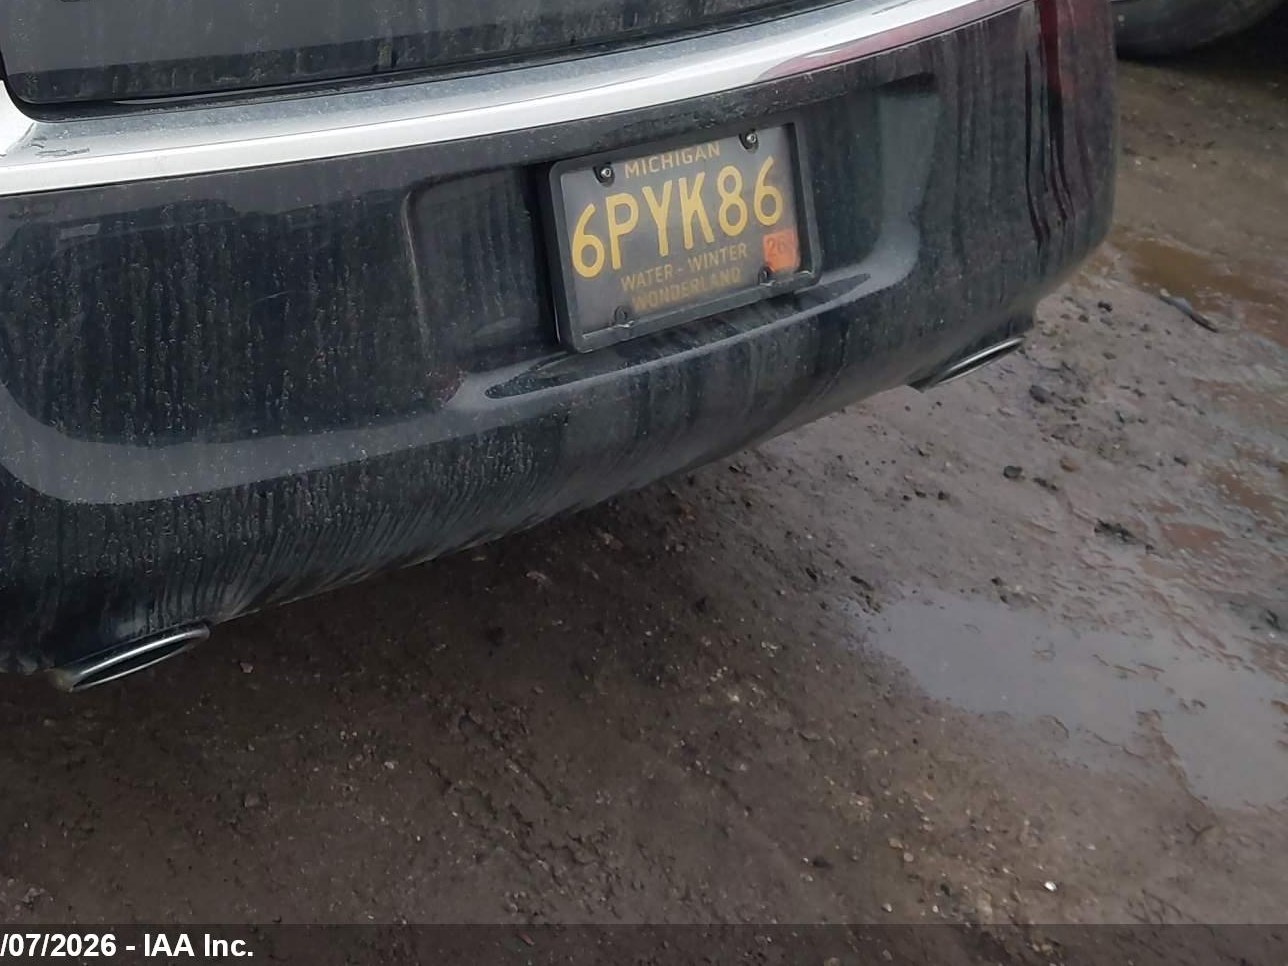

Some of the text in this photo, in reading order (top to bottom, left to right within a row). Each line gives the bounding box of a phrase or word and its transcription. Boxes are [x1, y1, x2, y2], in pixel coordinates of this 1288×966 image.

[624, 141, 721, 179] MICHIGAN
[571, 155, 784, 279] 6PYK86
[620, 264, 673, 292] WATER
[687, 241, 749, 274] WINTER
[631, 266, 742, 311] WONDERLAND
